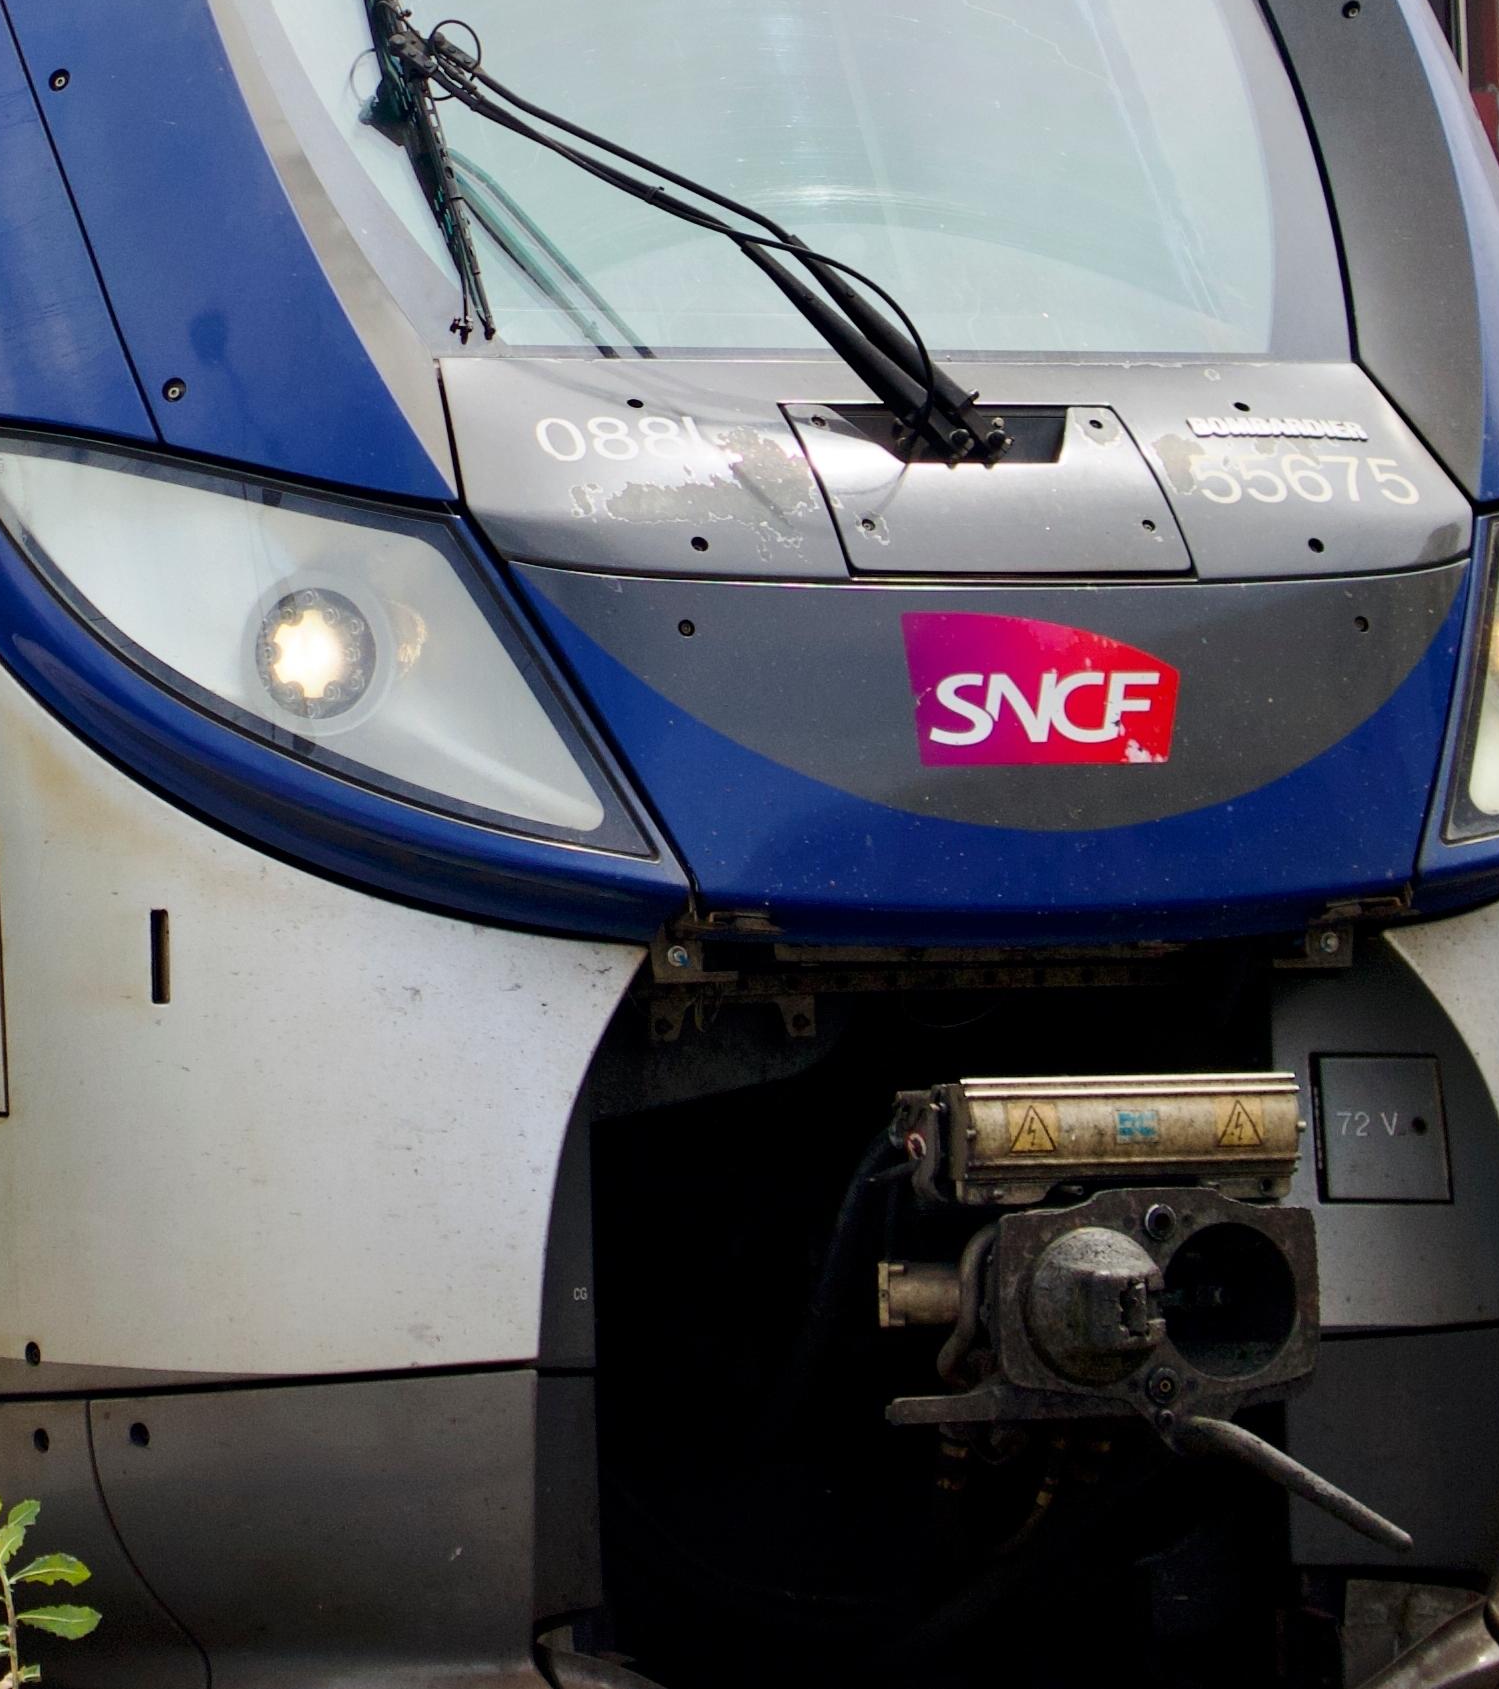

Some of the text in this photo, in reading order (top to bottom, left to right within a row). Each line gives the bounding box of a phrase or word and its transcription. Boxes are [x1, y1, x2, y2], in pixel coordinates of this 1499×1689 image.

[1186, 416, 1369, 443] BOMBARDIER
[1188, 453, 1420, 506] 55675
[928, 669, 1160, 747] SNCF
[1336, 1111, 1398, 1137] 72 V
[573, 1286, 588, 1301] CG
